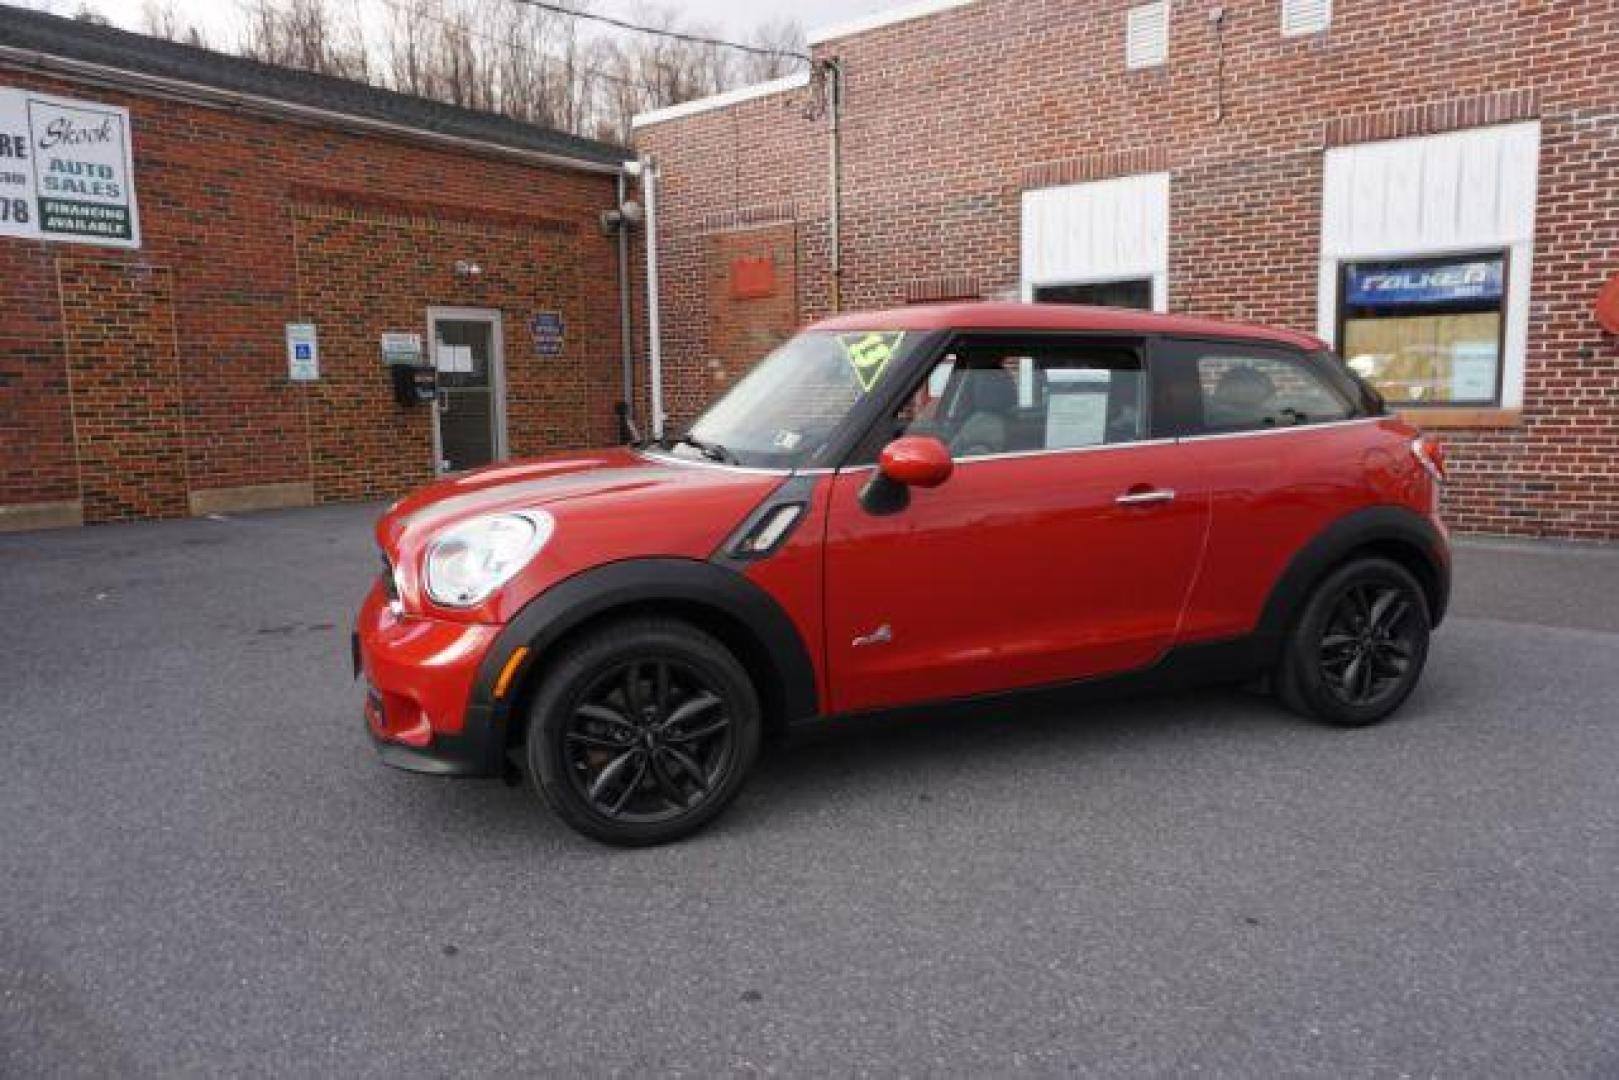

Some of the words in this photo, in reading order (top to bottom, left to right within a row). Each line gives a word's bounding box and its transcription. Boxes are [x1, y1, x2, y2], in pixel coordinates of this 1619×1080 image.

[50, 158, 114, 181] AUTO
[43, 176, 120, 198] SALES
[45, 201, 125, 221] FINANCING
[47, 215, 125, 234] AVAILABLE
